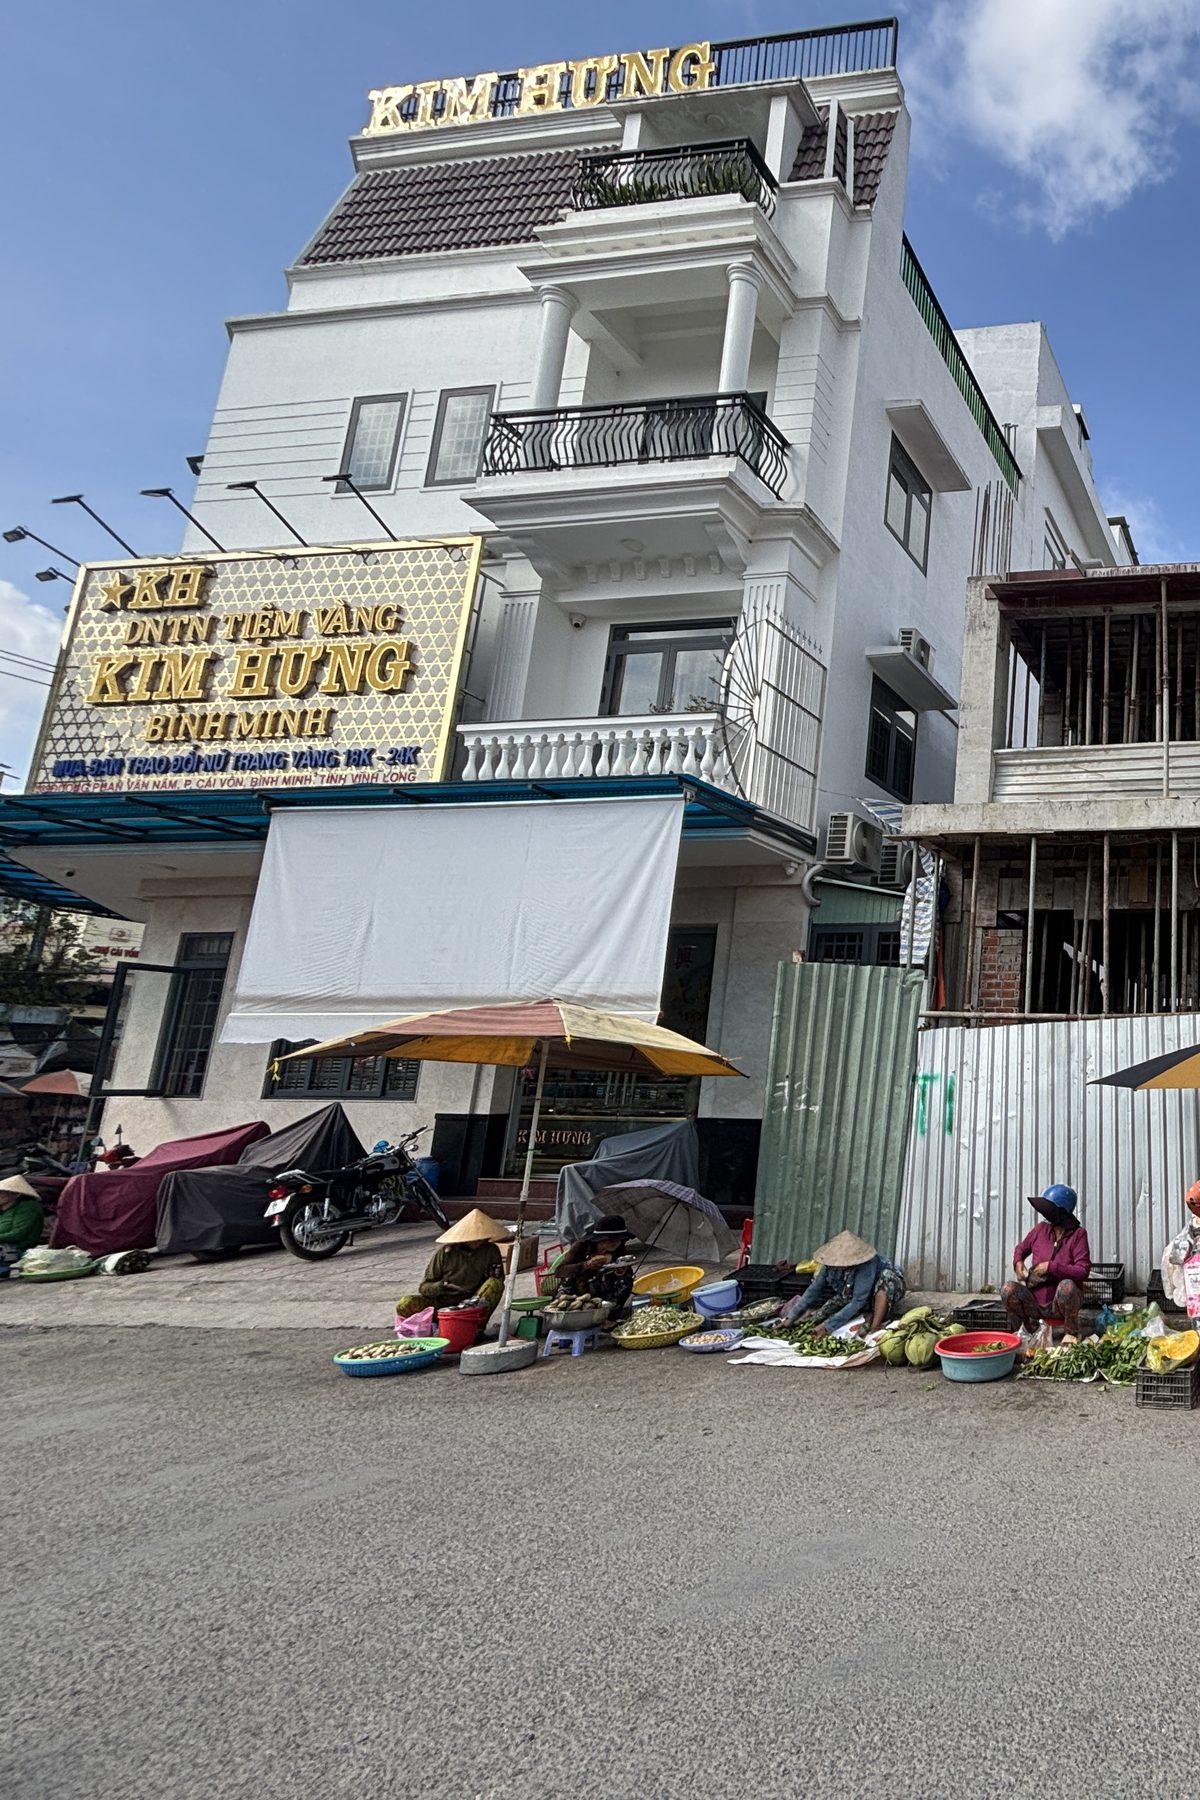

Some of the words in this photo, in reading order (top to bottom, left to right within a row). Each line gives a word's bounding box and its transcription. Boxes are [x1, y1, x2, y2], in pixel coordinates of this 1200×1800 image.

[362, 72, 499, 137] KIM
[515, 41, 715, 116] HƯNG
[127, 566, 206, 609] KH
[124, 613, 212, 646] DNTN
[223, 602, 303, 645] TIỆM
[313, 599, 402, 635] VÀNG
[86, 649, 213, 703] KIM
[226, 640, 412, 699] HƯNG
[145, 705, 227, 743] BÌNH
[233, 707, 334, 739] MINH
[126, 757, 170, 775] TRAO
[232, 750, 289, 771] TRANG
[293, 747, 339, 770] VÀNG
[344, 748, 374, 767] 18K
[385, 746, 420, 766] 24K
[196, 776, 217, 789] CÁI
[382, 770, 417, 784] LONG
[517, 1129, 548, 1144] KM
